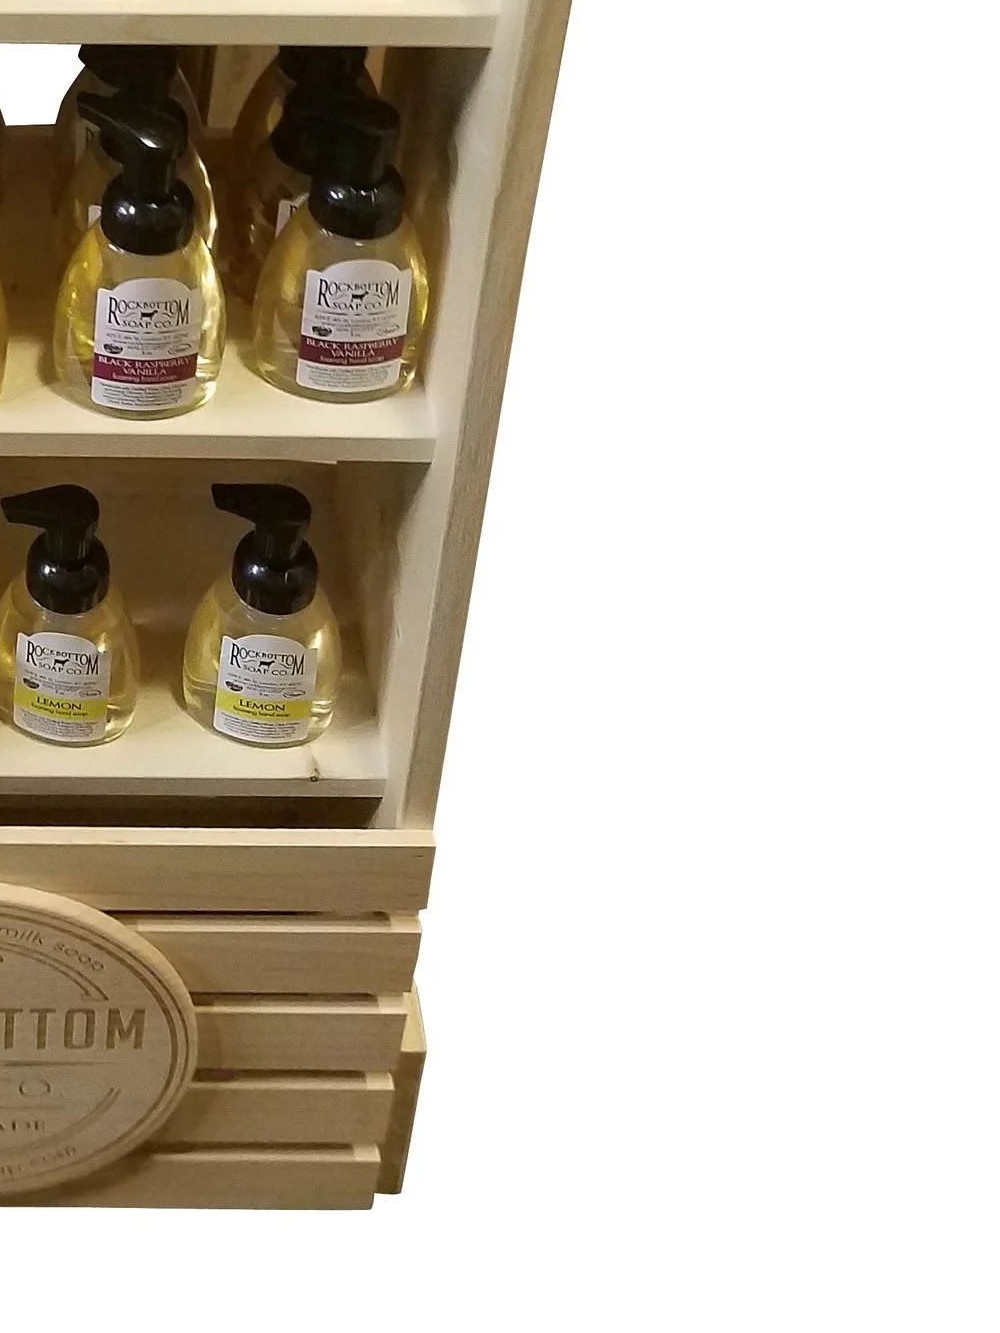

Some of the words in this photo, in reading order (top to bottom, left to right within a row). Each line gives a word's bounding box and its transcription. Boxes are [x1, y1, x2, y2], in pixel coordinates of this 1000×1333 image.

[316, 278, 400, 309] ROCKBOTTOM
[107, 295, 190, 327] ROCKBOTTOM
[331, 301, 361, 311] SOAP
[121, 319, 151, 330] SOAP
[305, 337, 341, 350] BLACK
[343, 336, 399, 351] RASPBERRY
[330, 348, 376, 358] VANILLA
[98, 355, 133, 367] BLACK
[134, 356, 190, 368] RASPBERRY
[123, 366, 168, 376] VANILLA
[26, 640, 99, 675] ROCKBOTTOM
[229, 642, 305, 676] ROCKBOTTOM
[38, 662, 64, 673] SOAP
[242, 664, 269, 675] SOAP
[36, 696, 82, 711] LEMON
[239, 698, 286, 712] LEMON
[53, 940, 106, 973] soap
